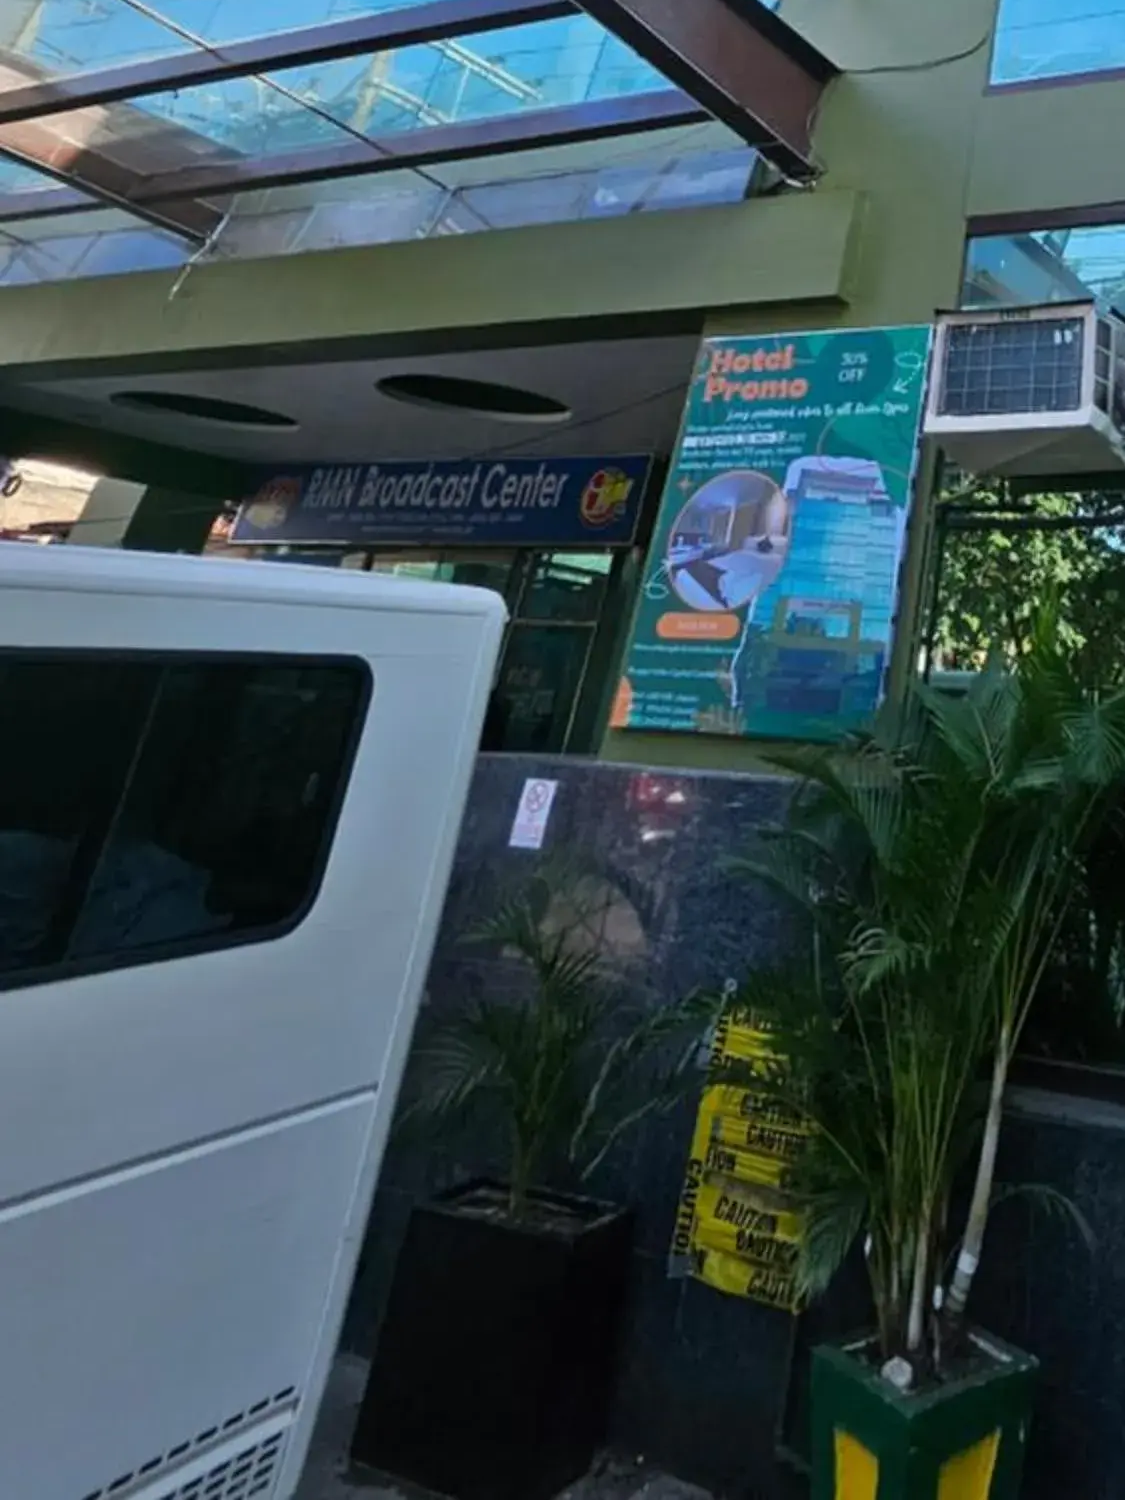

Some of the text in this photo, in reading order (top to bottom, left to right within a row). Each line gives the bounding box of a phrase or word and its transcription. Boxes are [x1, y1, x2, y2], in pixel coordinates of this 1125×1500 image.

[709, 344, 794, 373] Hotel
[838, 367, 867, 383] OFF
[703, 376, 809, 403] Promo
[302, 465, 362, 509] RMN
[357, 462, 482, 509] Broadcast
[480, 462, 570, 509] Center
